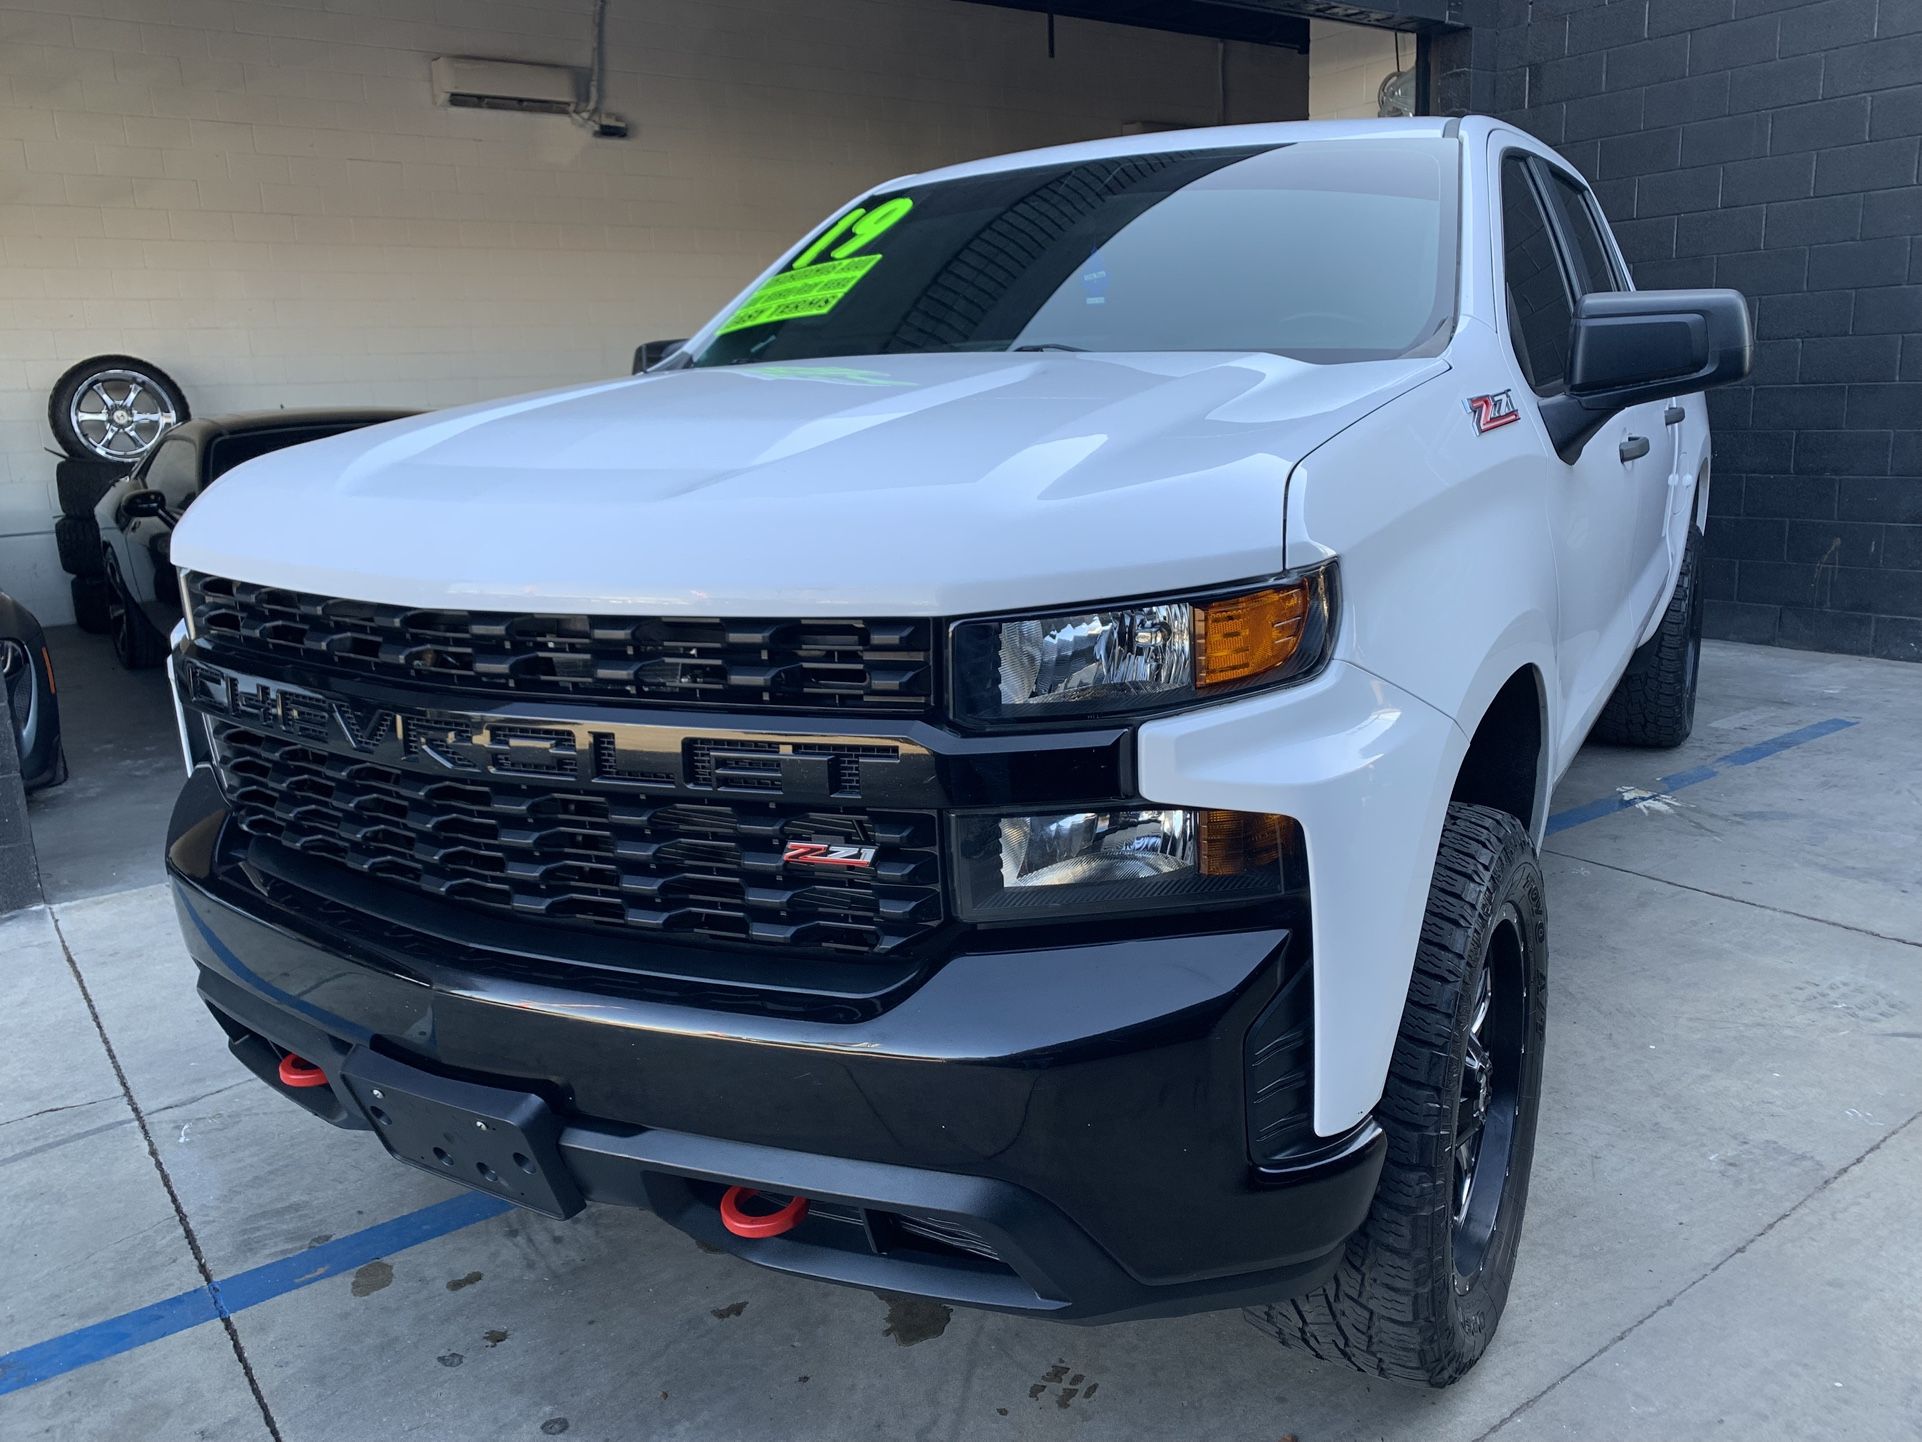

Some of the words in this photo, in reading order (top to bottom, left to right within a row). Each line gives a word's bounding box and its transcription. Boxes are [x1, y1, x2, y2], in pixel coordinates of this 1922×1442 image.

[792, 197, 914, 269] 19
[187, 664, 900, 798] CHEVROLET
[783, 840, 878, 868] Z71
